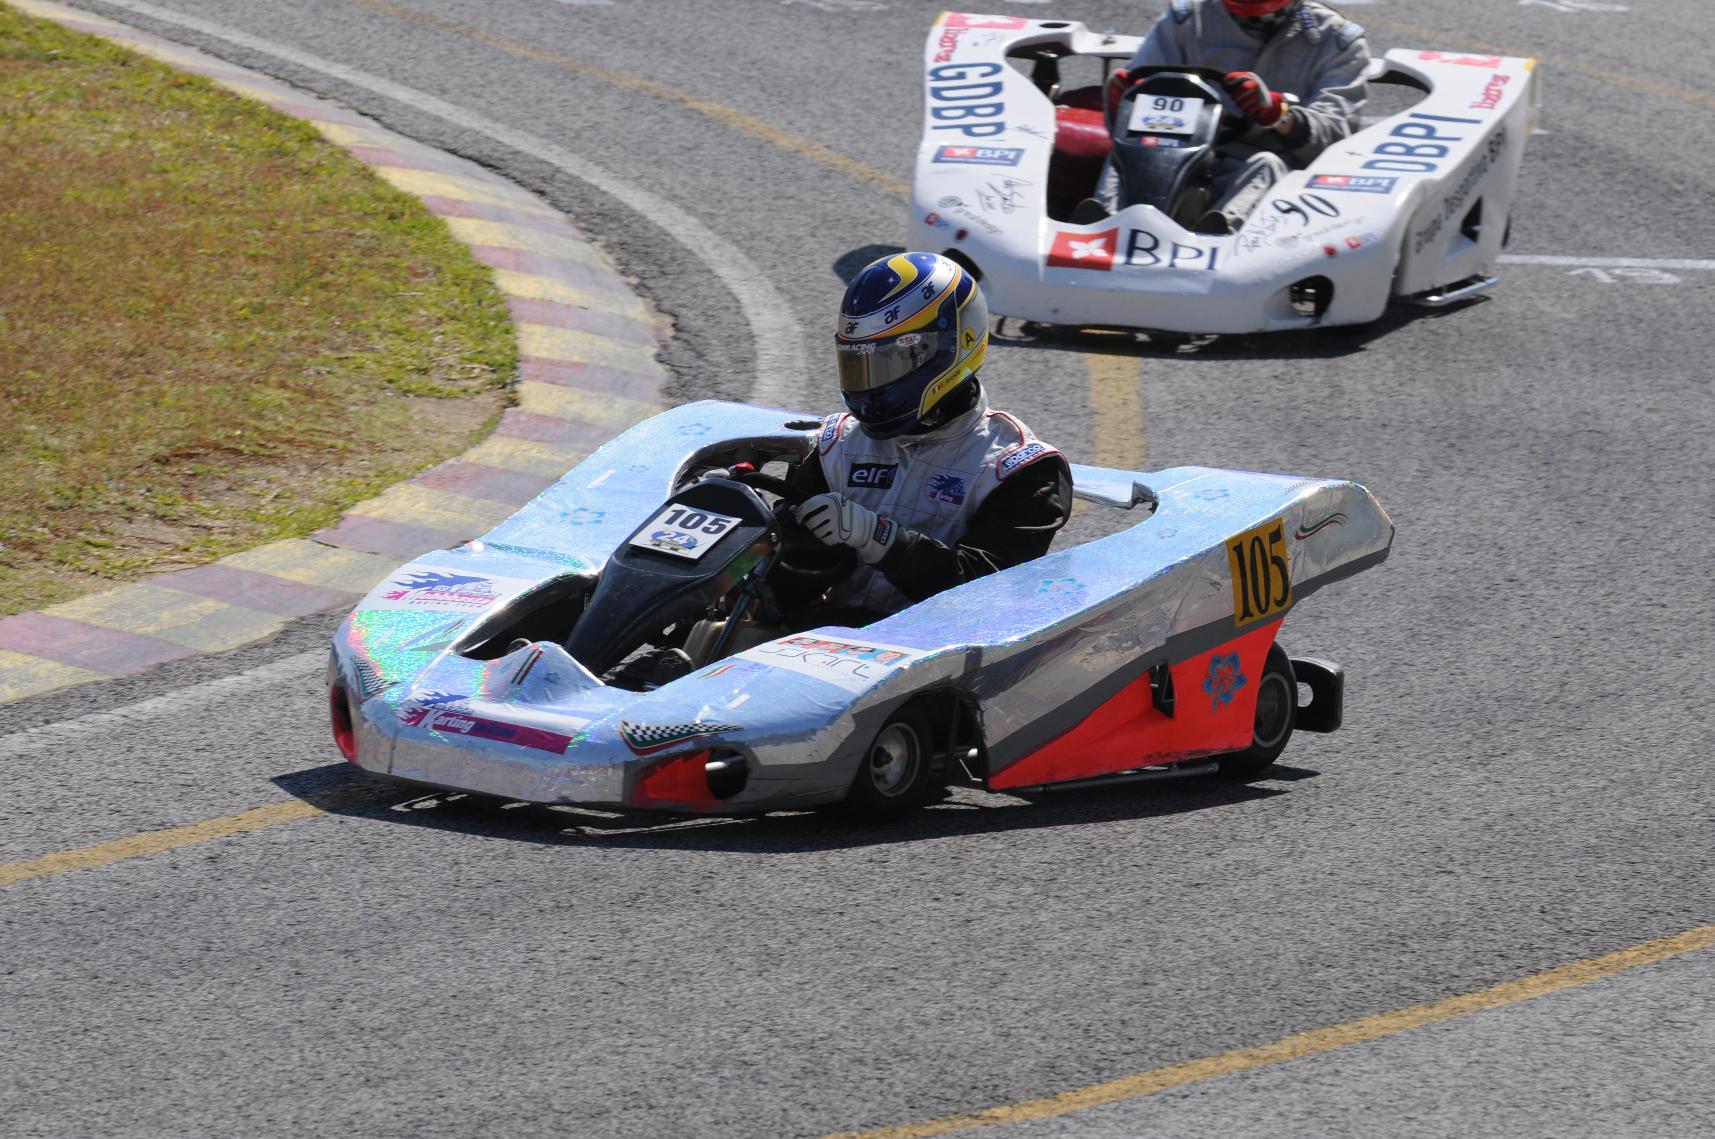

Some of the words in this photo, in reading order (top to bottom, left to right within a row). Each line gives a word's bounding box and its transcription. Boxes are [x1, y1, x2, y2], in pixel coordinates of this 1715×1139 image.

[1153, 98, 1184, 112] 90
[976, 149, 1018, 159] BPI
[1351, 178, 1391, 187] BPI
[1272, 193, 1340, 227] 90
[1123, 228, 1220, 271] BPI
[1004, 443, 1043, 467] sparco
[852, 467, 889, 484] elf
[664, 509, 731, 535] 105
[1232, 525, 1290, 622] 105
[416, 708, 476, 734] Karting
